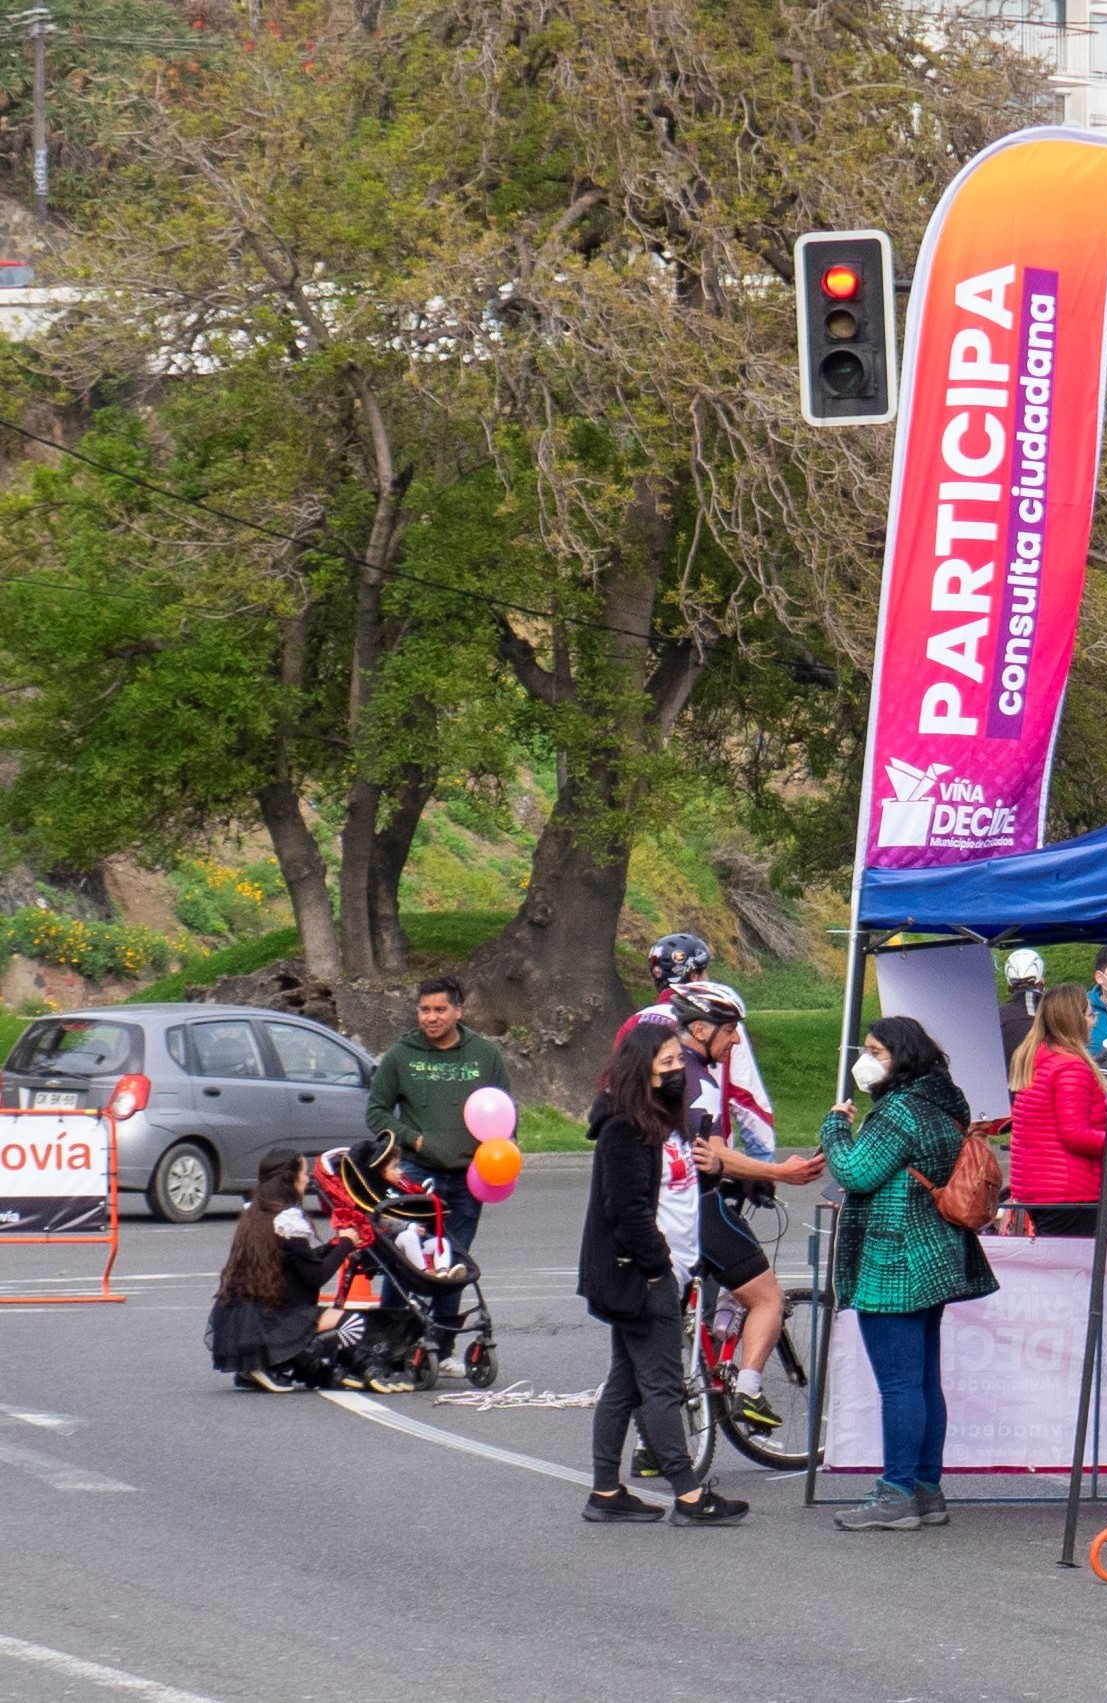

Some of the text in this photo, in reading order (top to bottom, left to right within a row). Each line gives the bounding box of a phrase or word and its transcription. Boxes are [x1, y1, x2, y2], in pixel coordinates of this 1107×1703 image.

[918, 264, 1016, 736] PARTICIPA
[998, 294, 1056, 716] consulta ciudadana
[929, 836, 975, 851] Municipio
[1, 1131, 92, 1171] ovía
